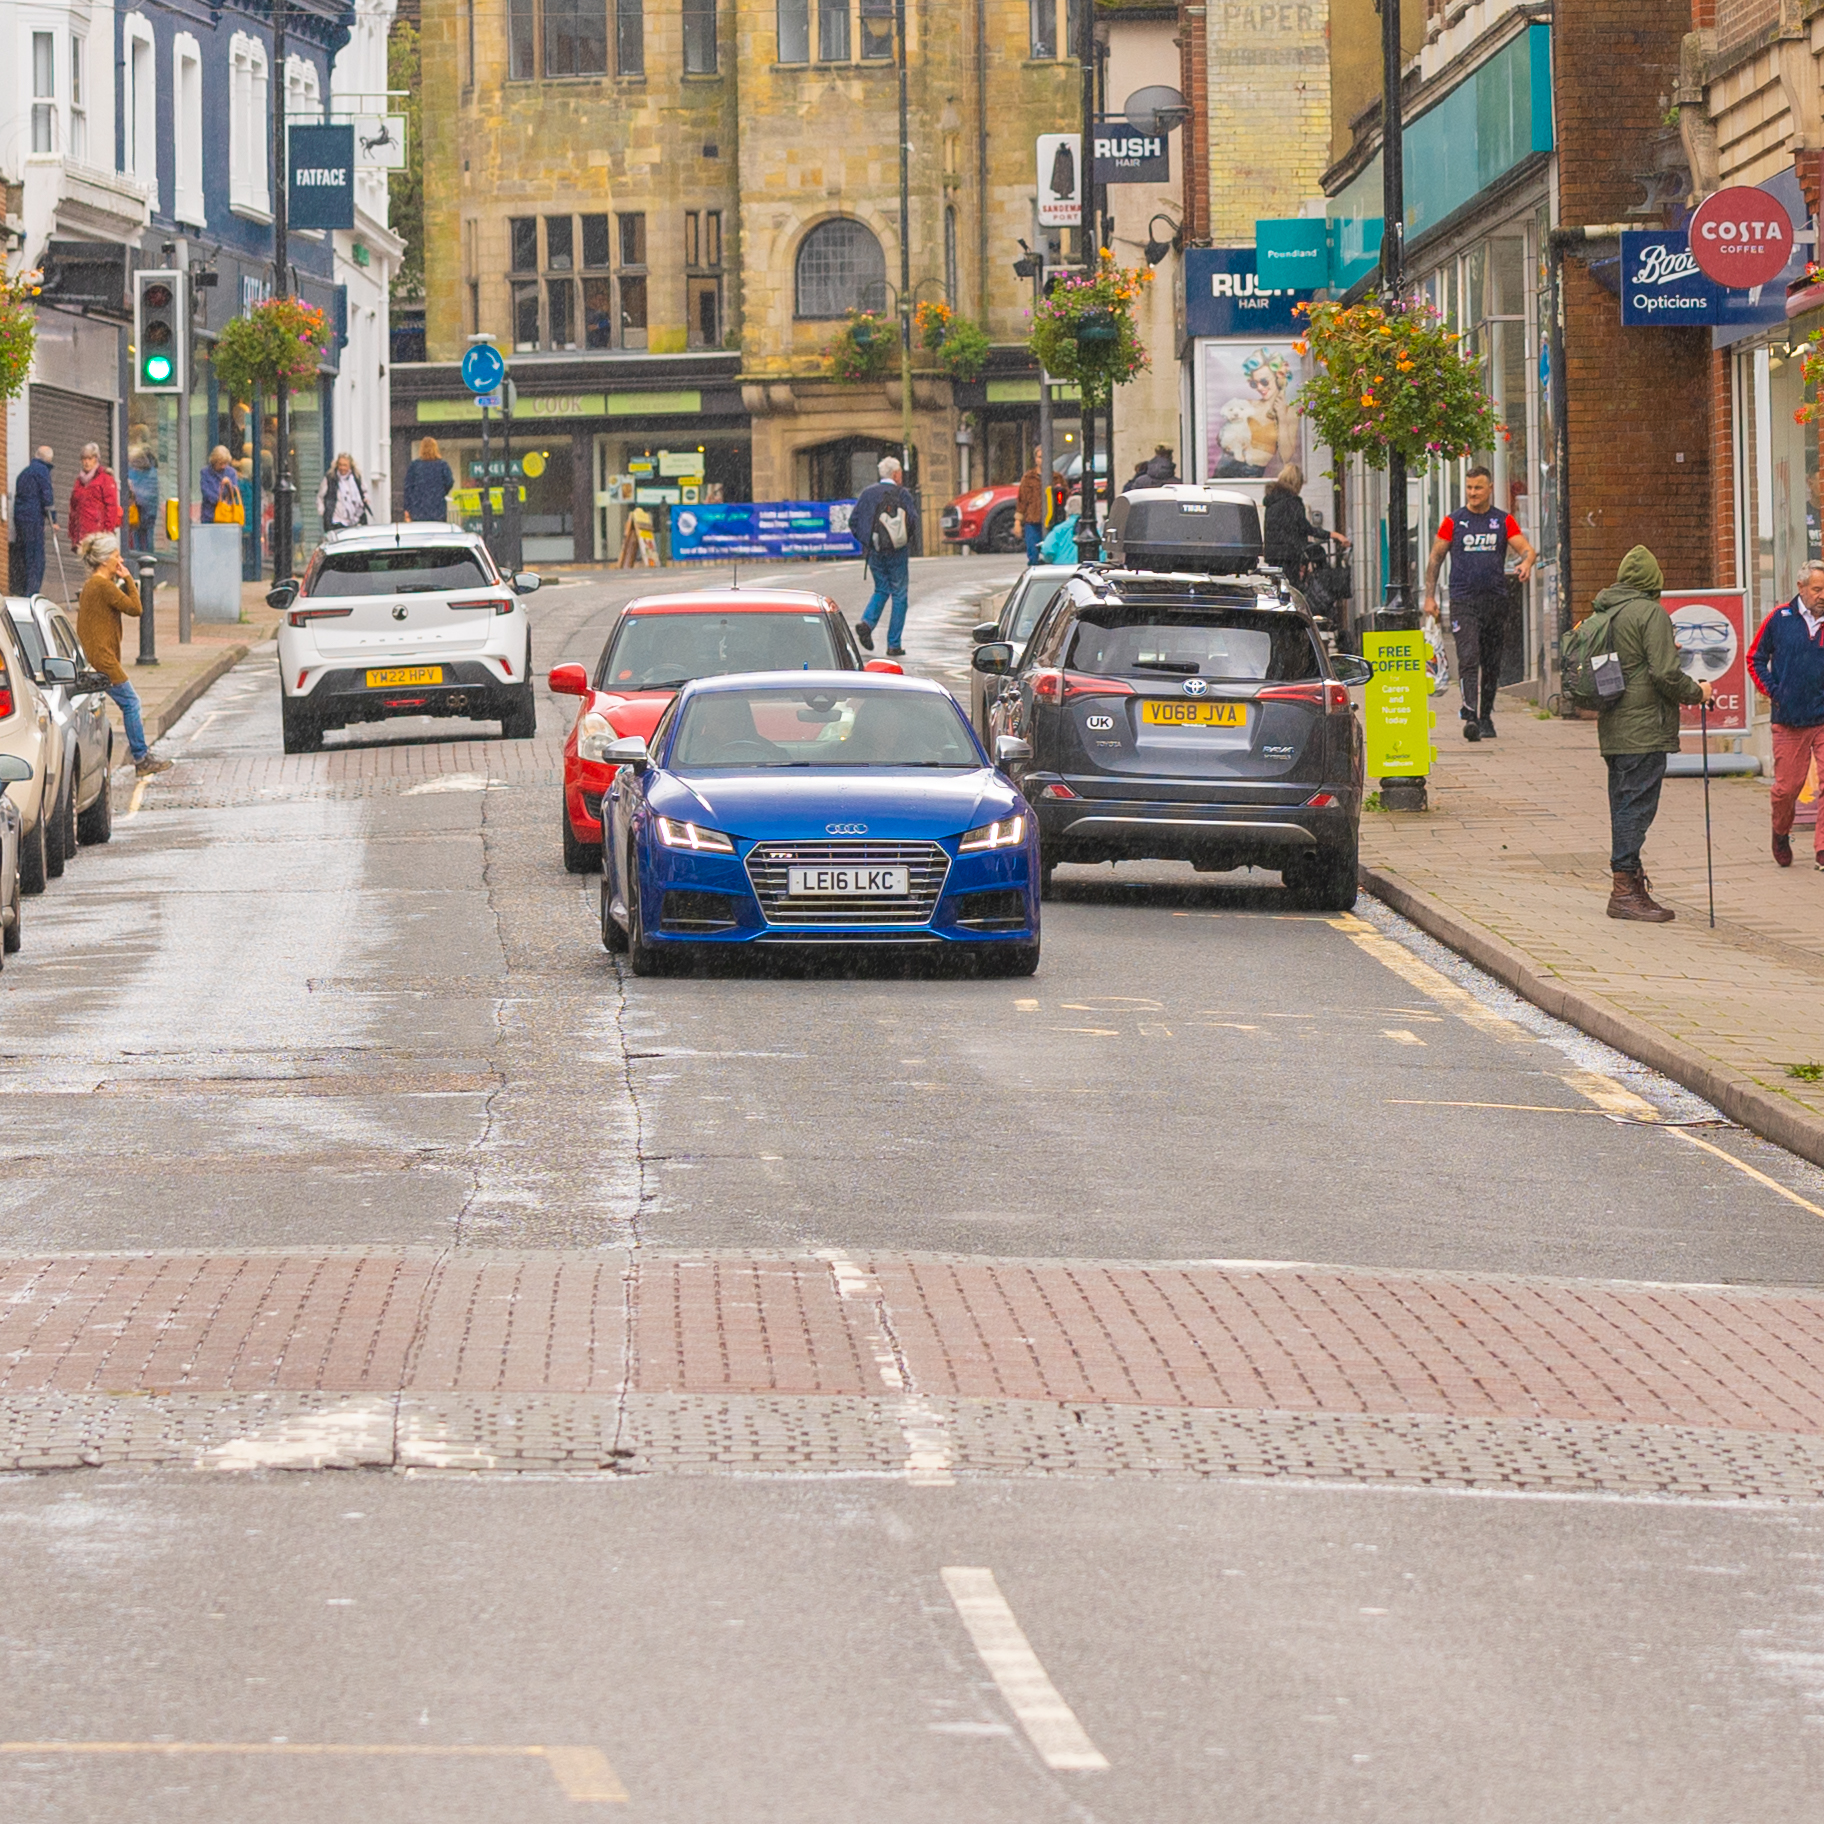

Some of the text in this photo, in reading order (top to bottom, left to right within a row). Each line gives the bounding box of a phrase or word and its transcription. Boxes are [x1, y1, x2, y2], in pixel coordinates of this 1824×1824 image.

[1094, 137, 1161, 158] RUSH
[1116, 158, 1141, 167] HAIR
[296, 168, 347, 186] FATFACE
[1701, 221, 1783, 243] COSTA
[1267, 248, 1318, 259] Poundland
[1720, 245, 1765, 254] COFFEE
[1238, 299, 1269, 309] HAIR
[1633, 294, 1707, 313] Opticians
[532, 396, 584, 415] COOK
[1378, 646, 1412, 657] FREE
[1371, 659, 1421, 672] COFFEE
[409, 668, 435, 682] HPV
[1382, 685, 1410, 693] Carers
[1389, 695, 1404, 703] and
[1151, 704, 1237, 722] VO68 JVA
[1381, 706, 1411, 714] Nurses
[1090, 717, 1110, 728] UK
[1385, 716, 1408, 725] today
[803, 871, 894, 891] LE16 LKC
